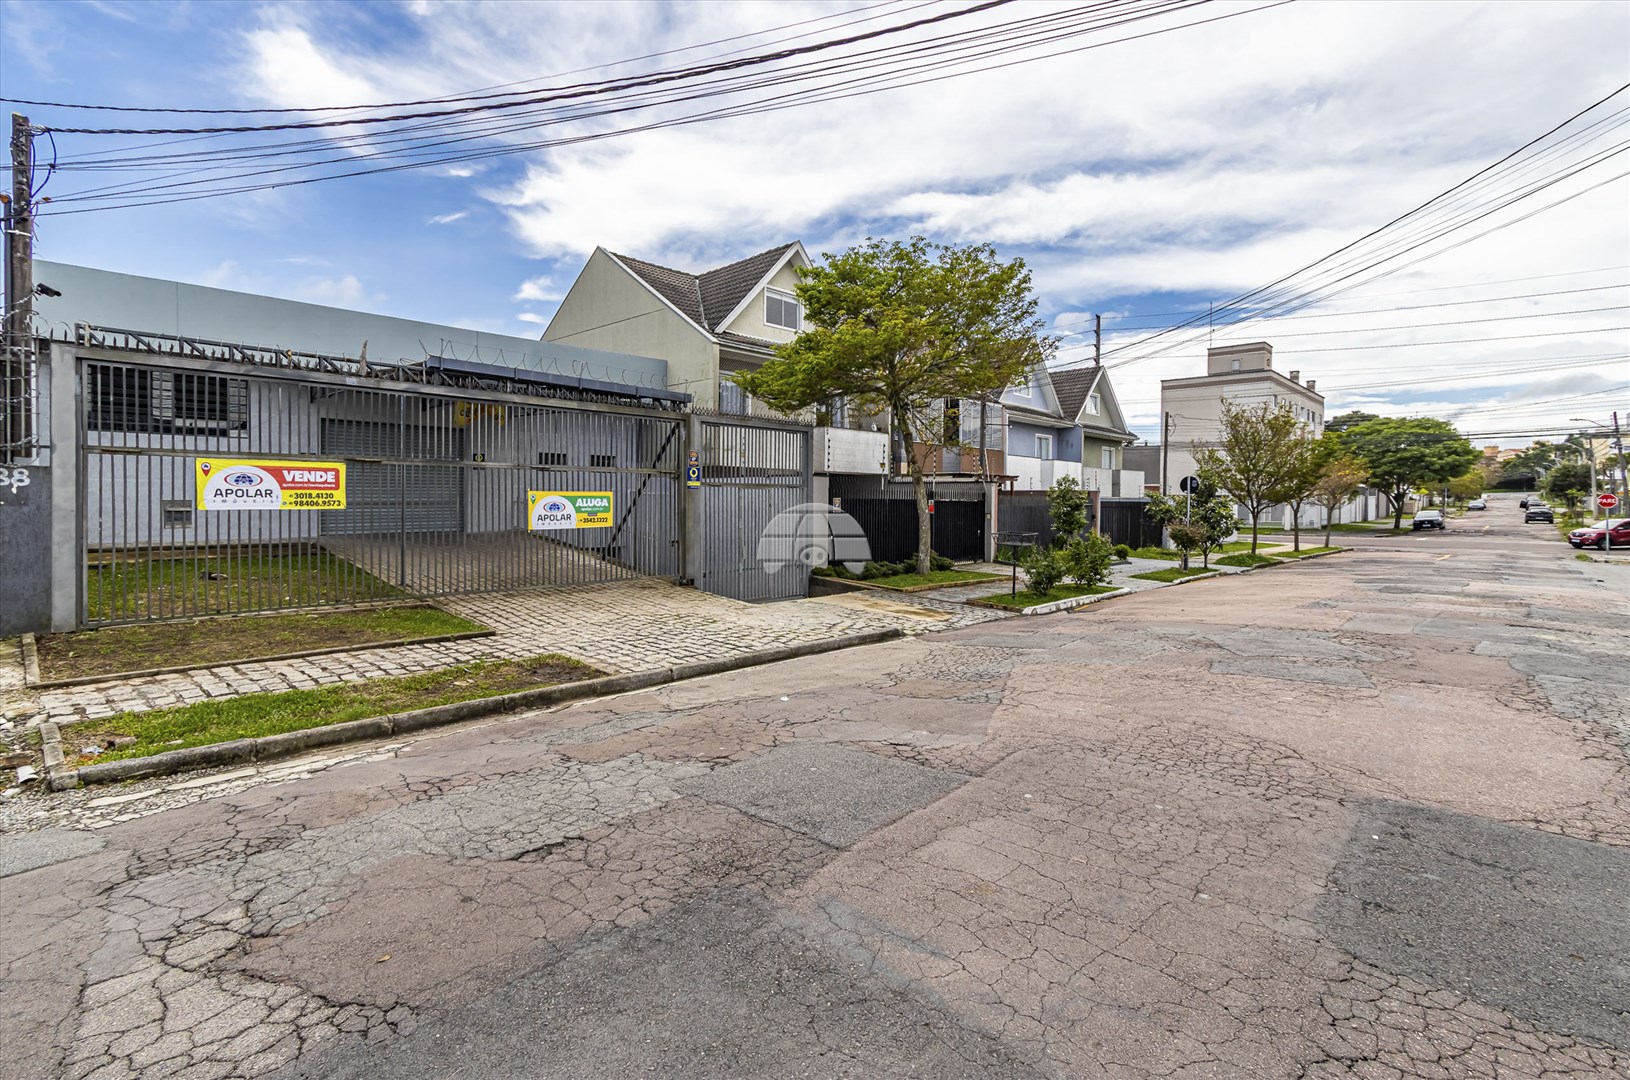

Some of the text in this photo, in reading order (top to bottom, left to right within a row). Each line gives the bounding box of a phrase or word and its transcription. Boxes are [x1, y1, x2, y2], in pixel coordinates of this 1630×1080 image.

[282, 470, 336, 483] VENDE
[213, 488, 274, 498] APOLAR
[293, 492, 334, 500] 3018.4130
[575, 498, 609, 506] ALUGA
[537, 513, 572, 522] APOLAR
